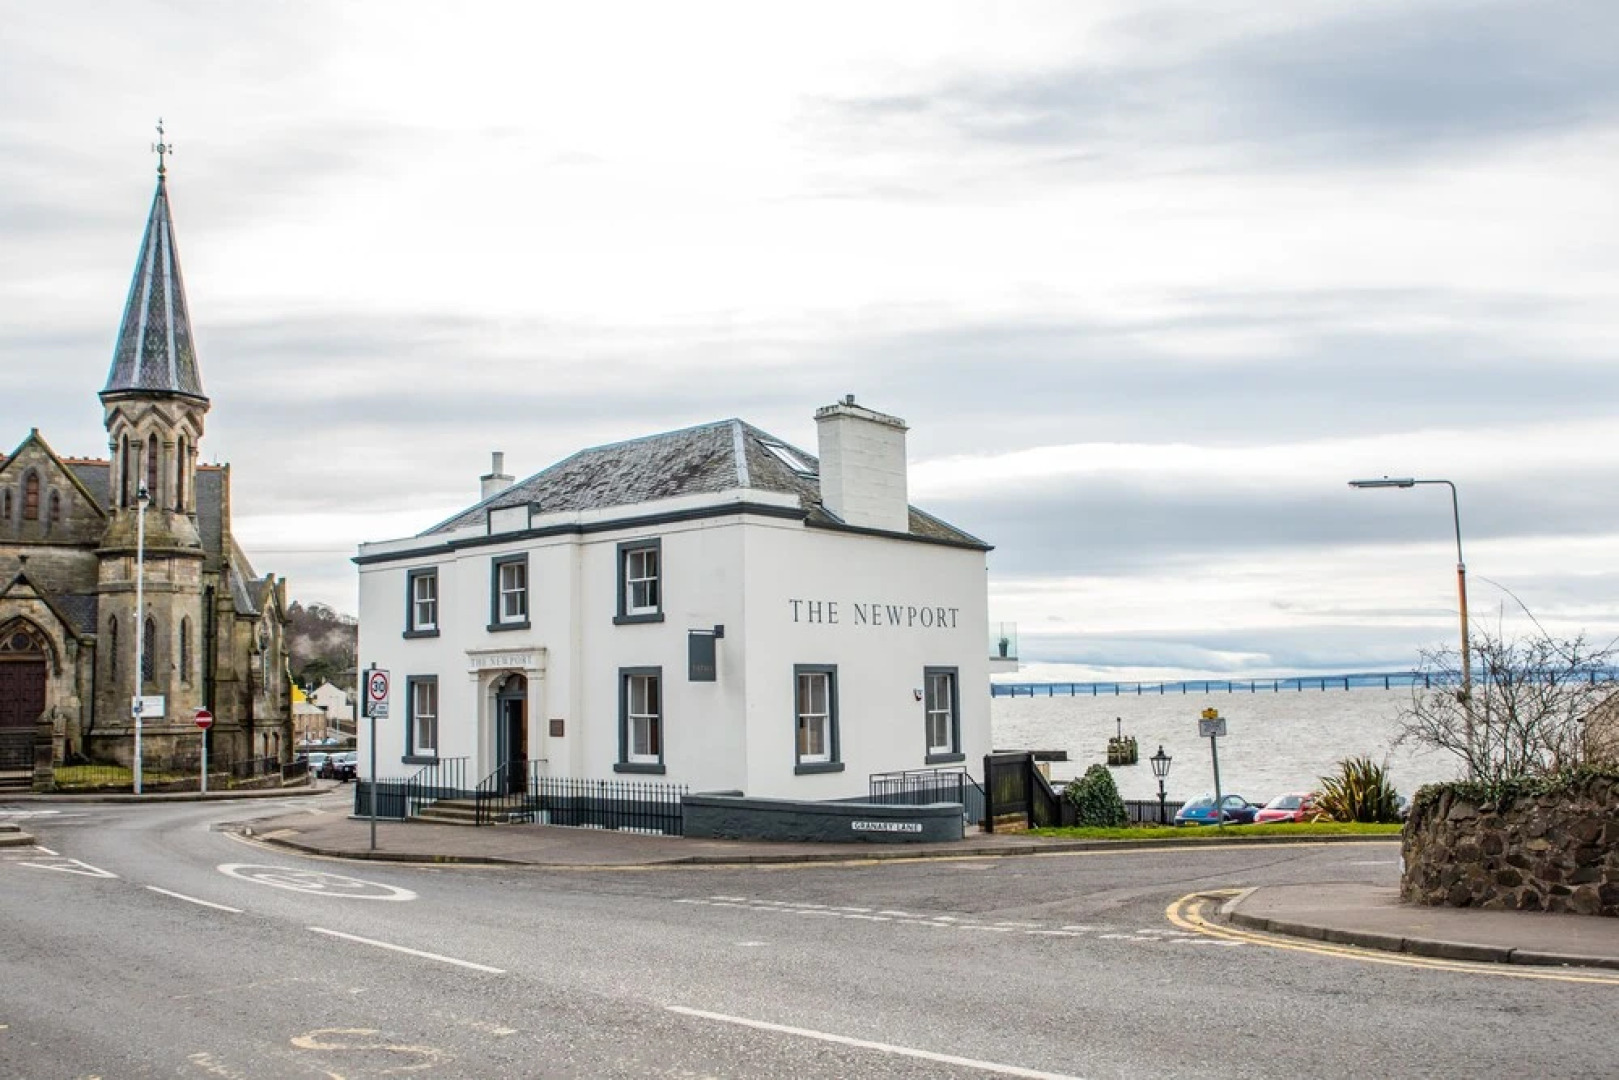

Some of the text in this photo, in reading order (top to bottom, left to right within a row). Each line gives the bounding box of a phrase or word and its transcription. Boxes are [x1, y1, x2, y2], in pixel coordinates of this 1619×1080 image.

[789, 599, 959, 628] THE NEWPORT
[471, 653, 532, 667] THE NEWPORT
[373, 681, 386, 692] 30
[853, 821, 918, 832] GRANARY LANE
